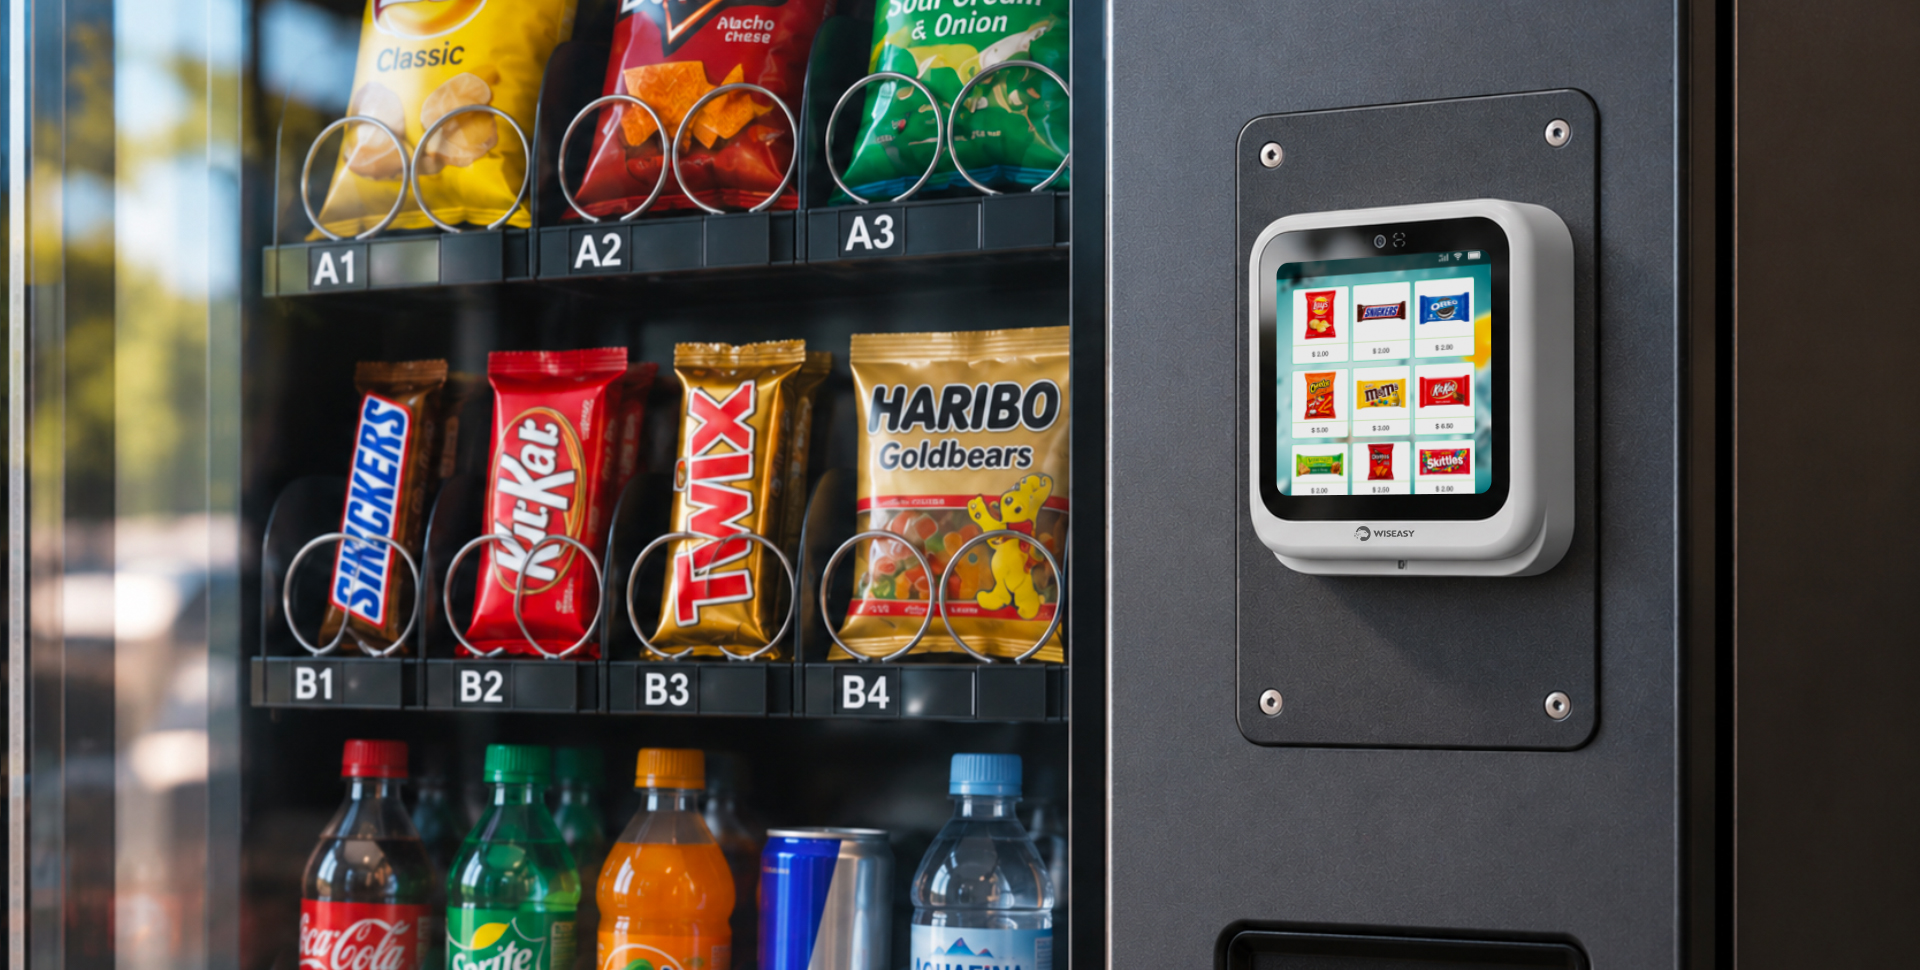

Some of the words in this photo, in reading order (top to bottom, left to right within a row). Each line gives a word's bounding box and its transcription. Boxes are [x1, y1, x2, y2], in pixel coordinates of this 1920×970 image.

[911, 20, 927, 40] &
[934, 10, 1008, 37] Onion
[376, 41, 465, 72] Classic
[845, 214, 895, 251] A3
[313, 250, 355, 286] A1
[574, 233, 622, 269] A2
[868, 379, 1061, 434] HARIBO
[879, 438, 1033, 470] Goldbears
[1427, 455, 1464, 469] Skittles
[674, 380, 755, 627] TWIX
[1373, 529, 1415, 537] WISEASY
[296, 666, 332, 700] B1
[460, 670, 503, 702] B2
[645, 672, 689, 706] B3
[842, 675, 890, 709] B4
